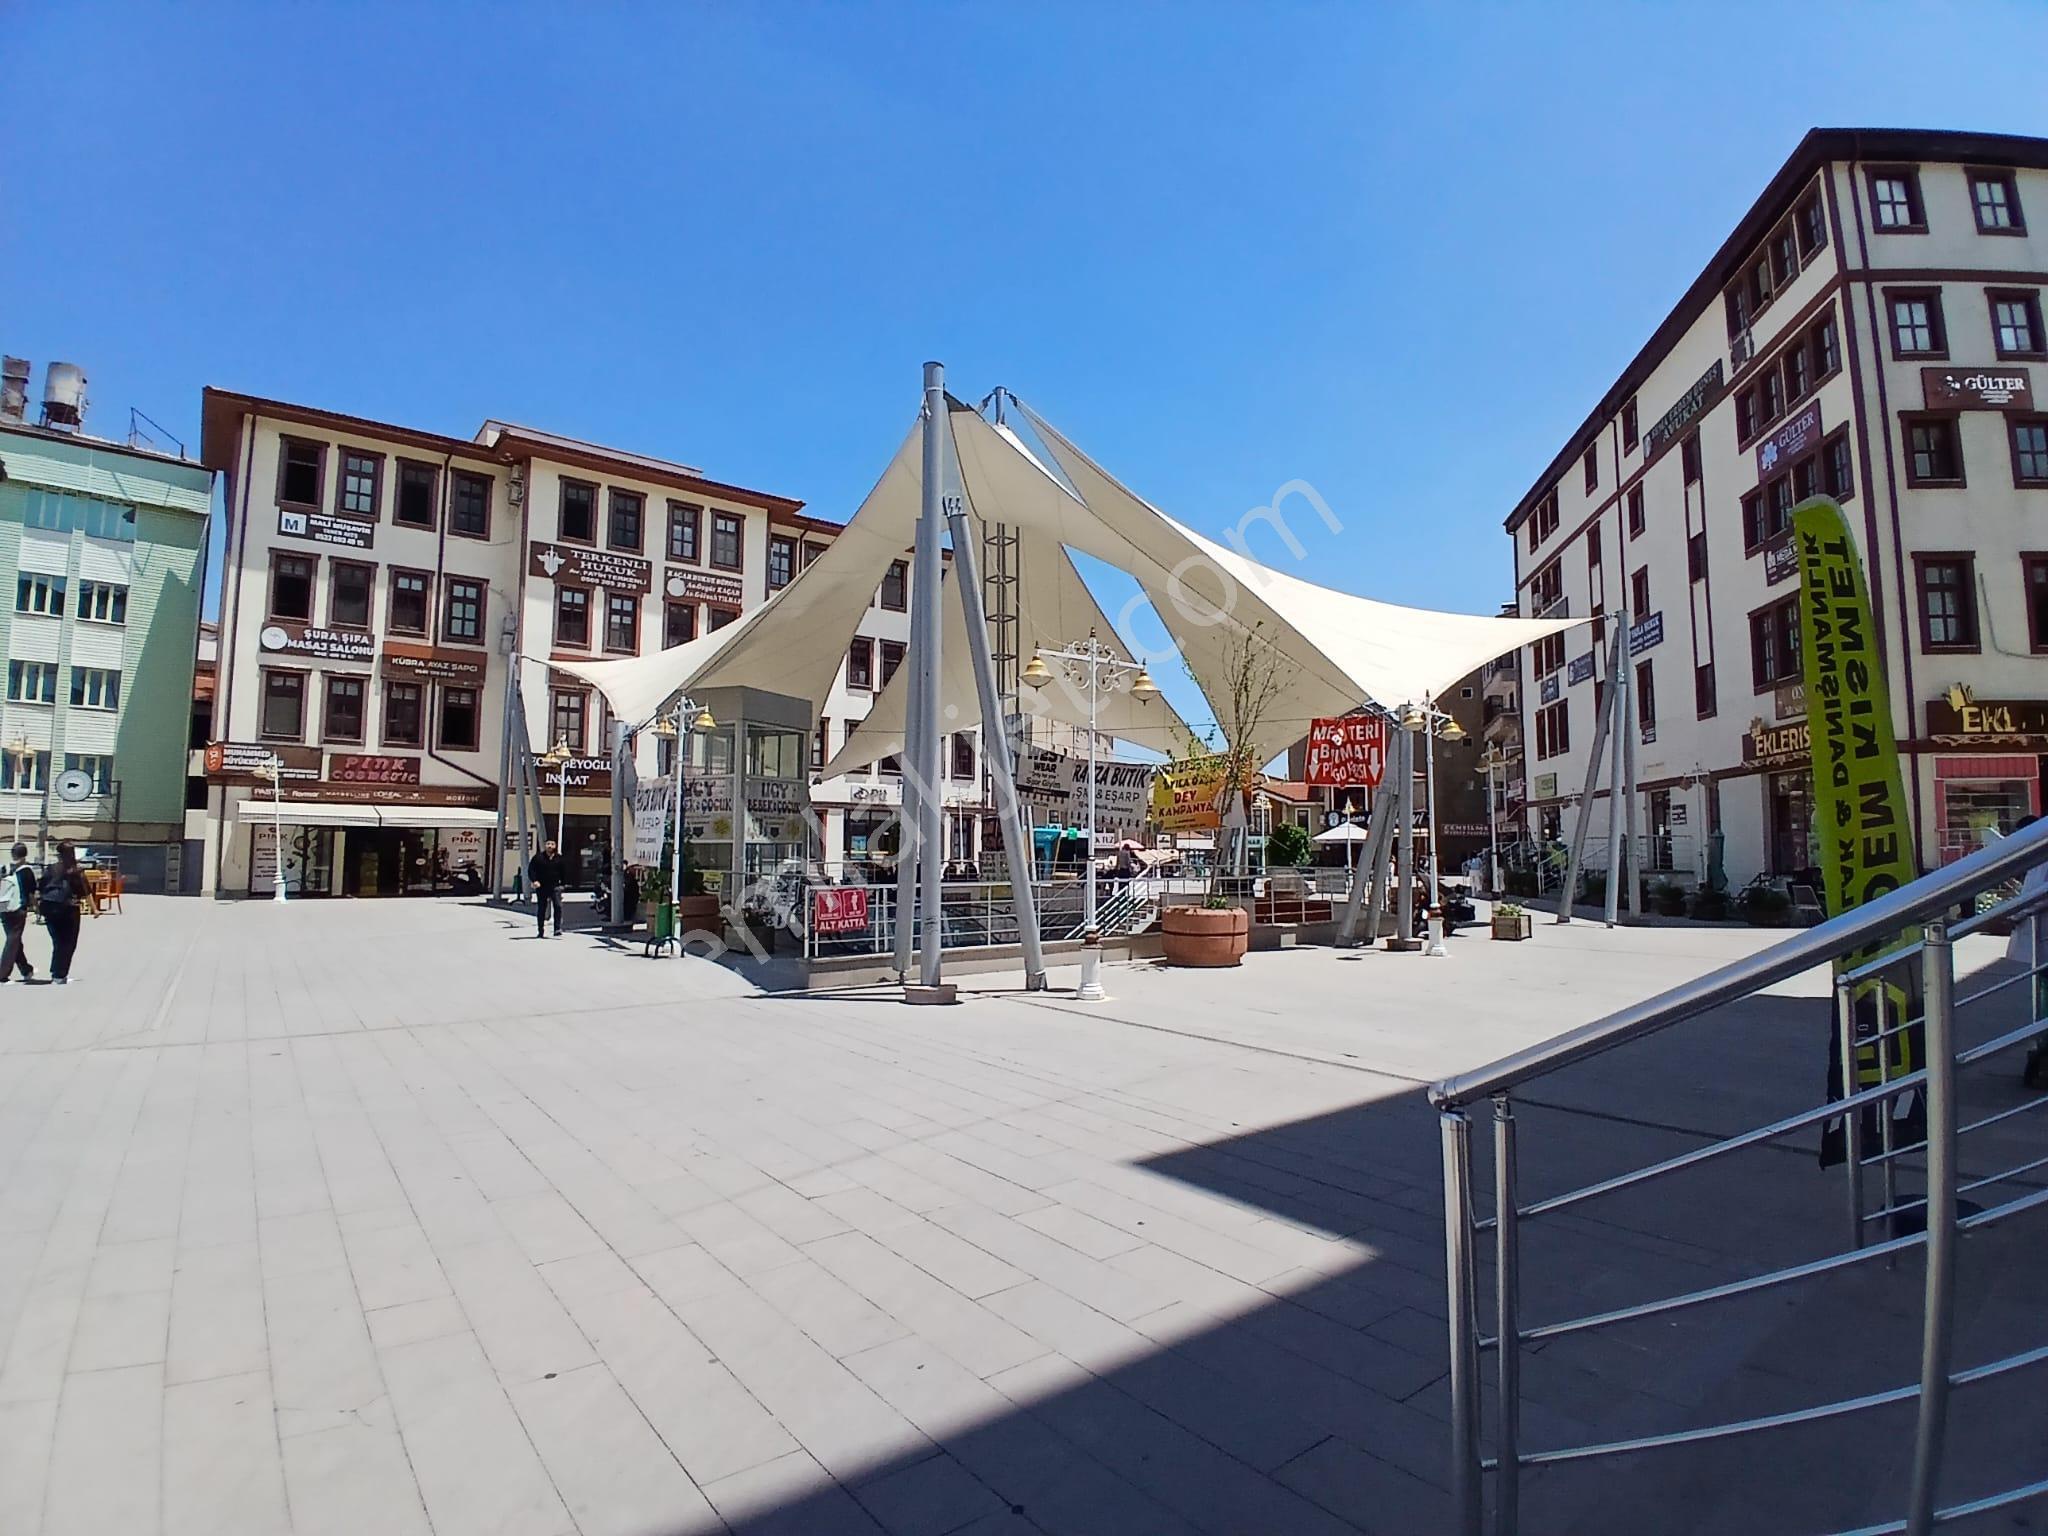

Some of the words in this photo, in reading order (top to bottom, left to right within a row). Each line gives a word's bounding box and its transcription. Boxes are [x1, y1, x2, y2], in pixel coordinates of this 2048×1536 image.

[1965, 374, 2025, 390] GÜLTER
[1663, 392, 1704, 442] AVUKAT
[284, 518, 299, 531] M
[580, 561, 636, 577] HUKUK
[287, 639, 328, 651] MASAJ
[329, 643, 374, 656] SALONU
[392, 657, 425, 668] KÜBRA
[1034, 762, 1057, 773] WEAR
[1072, 765, 1110, 786] RAZA
[1105, 790, 1140, 804] EŞARP
[820, 921, 837, 931] ALT
[838, 918, 866, 929] KATTA
